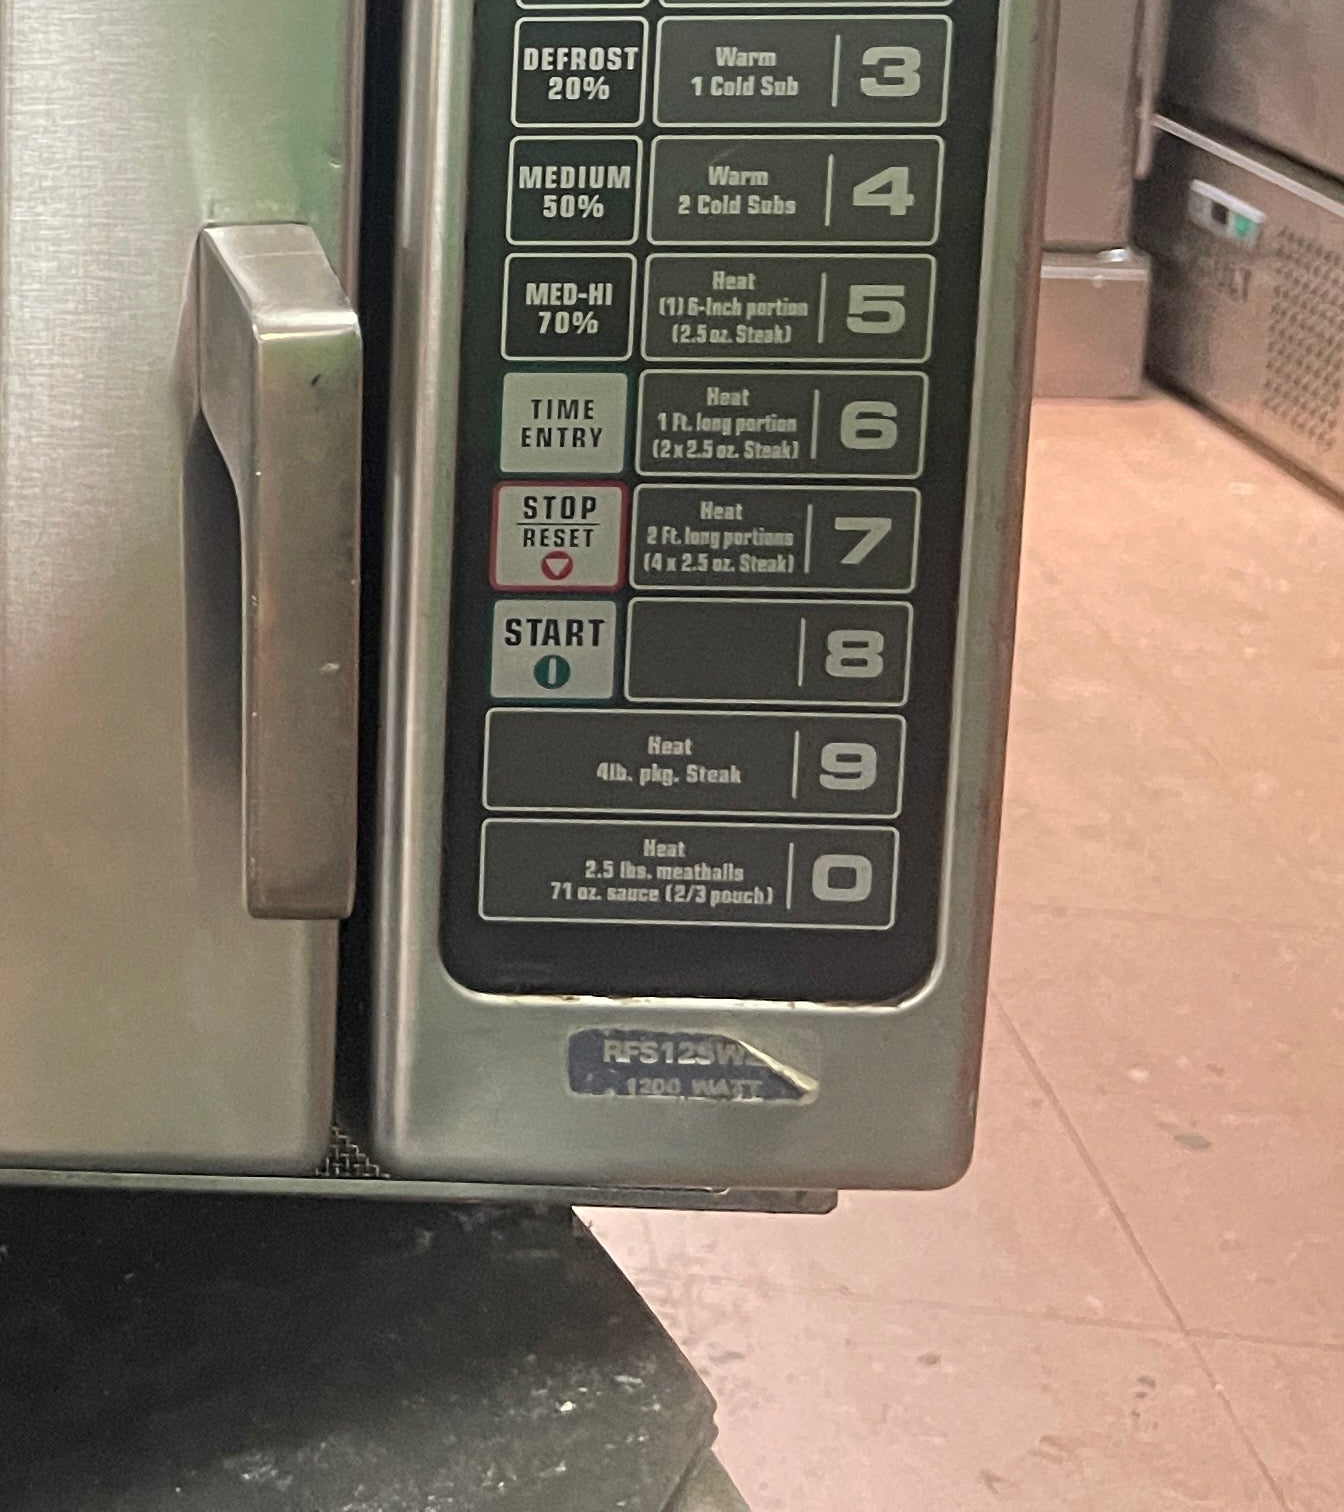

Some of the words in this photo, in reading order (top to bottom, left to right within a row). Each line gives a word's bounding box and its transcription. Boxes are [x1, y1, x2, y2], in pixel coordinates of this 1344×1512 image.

[521, 46, 641, 73] DEFROST
[715, 46, 777, 67] Warm
[859, 45, 921, 97] 3
[548, 76, 610, 100] 20%
[691, 76, 703, 96] 1
[710, 75, 755, 96] Cold
[760, 75, 799, 96] Sub
[517, 165, 633, 191] MEDIUM
[708, 165, 769, 186] Warm
[852, 166, 915, 216] 4
[542, 194, 604, 218] 50%
[678, 194, 691, 215] 2
[697, 194, 742, 215] Cold
[747, 194, 796, 215] Subs
[711, 270, 756, 290] Heat
[525, 282, 613, 306] MED-HI
[659, 296, 684, 316] (1)
[745, 297, 809, 321] portion
[846, 284, 906, 334] 5
[538, 311, 599, 335] 70%
[671, 323, 707, 344] (2.5
[709, 328, 733, 344] oz.
[735, 324, 792, 344] Steak)
[706, 386, 750, 407] Heat
[530, 398, 594, 420] TIME
[657, 412, 667, 431] 1
[672, 412, 693, 432] Ft.
[696, 412, 732, 436] long
[735, 413, 797, 437] portion
[840, 400, 898, 450] 6
[521, 427, 603, 448] ENTRY
[652, 438, 672, 459] (2
[673, 444, 684, 459] x
[686, 439, 714, 459] 2.5
[716, 444, 740, 459] oz.
[743, 439, 800, 460] Steak)
[520, 495, 599, 522] STOP
[700, 500, 743, 521] Heat
[520, 527, 596, 550] RESET
[646, 525, 658, 545] 2
[661, 525, 682, 545] Ft.
[684, 526, 721, 550] long
[722, 527, 794, 550] portions
[834, 516, 893, 565] 7
[643, 552, 663, 572] (4
[666, 557, 677, 572] x
[681, 552, 709, 572] 2.5
[712, 558, 736, 573] oz.
[739, 553, 795, 574] Steak)
[504, 618, 606, 647] START
[825, 629, 885, 679] 8
[647, 735, 693, 756] Heat
[596, 762, 633, 782] 4lb.
[639, 763, 680, 787] pkg.
[686, 763, 742, 784] Steak
[819, 742, 878, 791] 9
[643, 838, 686, 858] Heat
[585, 859, 614, 879] 2.5
[619, 860, 653, 880] lbs.
[811, 854, 873, 902] 0
[550, 881, 572, 900] 71
[577, 886, 602, 901] oz.
[606, 887, 660, 902] sauce
[665, 884, 707, 904] (2/3
[710, 886, 774, 908] pouch)
